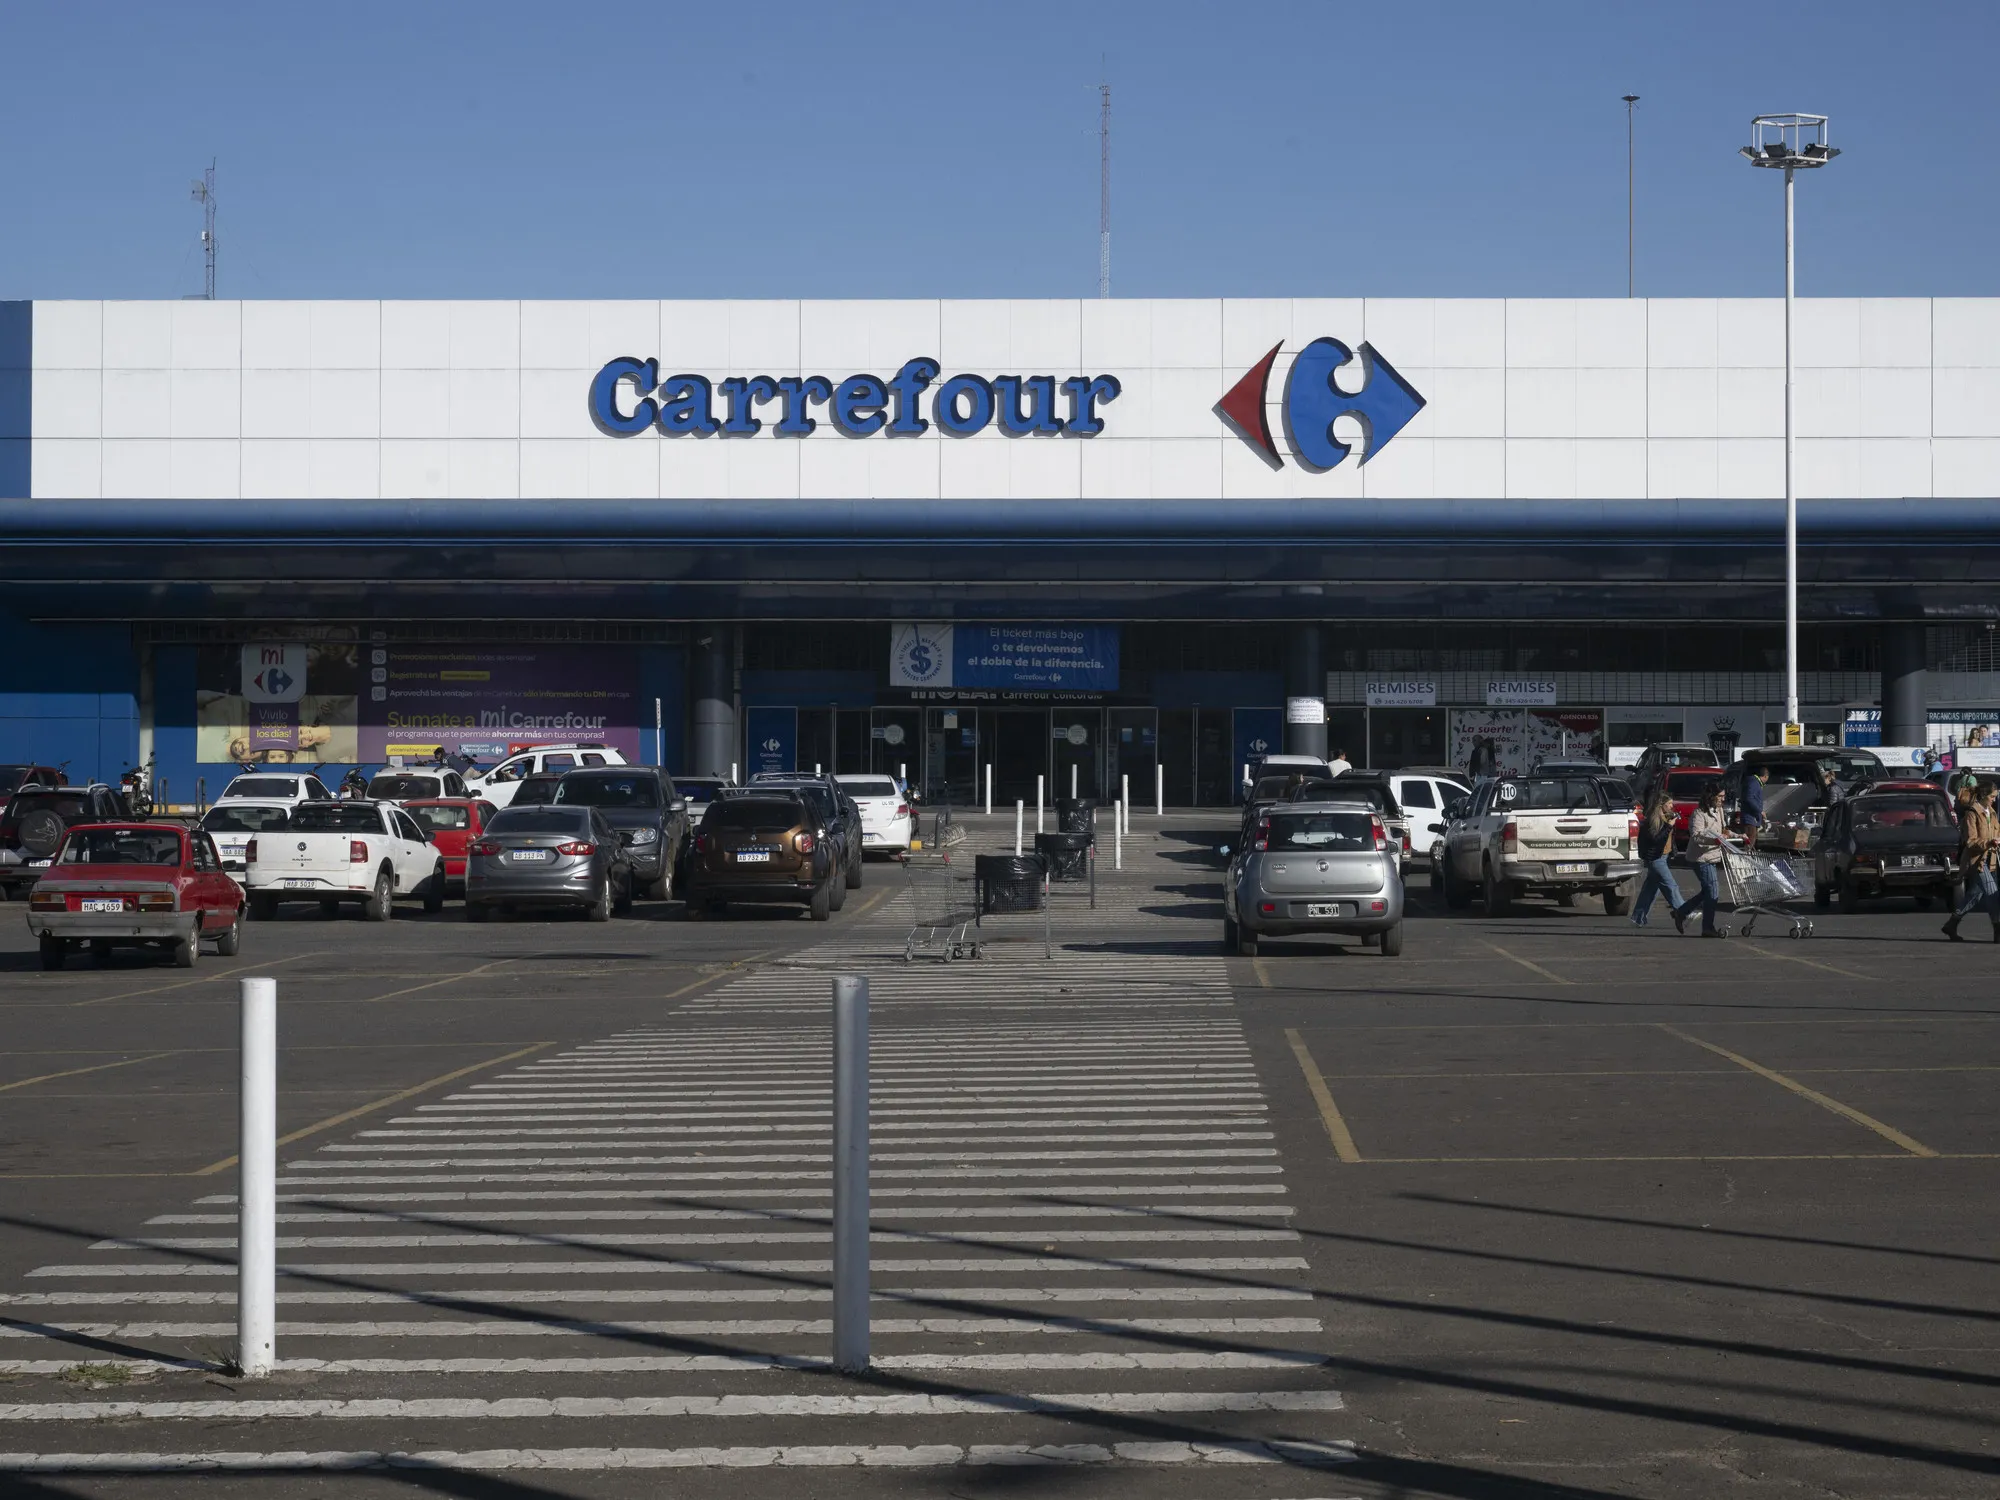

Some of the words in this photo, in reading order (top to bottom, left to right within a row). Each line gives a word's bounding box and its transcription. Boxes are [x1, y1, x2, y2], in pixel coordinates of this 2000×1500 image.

[590, 356, 1121, 438] Carrefour
[990, 628, 999, 638] El
[1002, 628, 1032, 638] ticket
[1060, 628, 1084, 642] bajo
[992, 644, 999, 652] o
[1002, 643, 1014, 652] te
[1016, 643, 1084, 654] devolvemos
[261, 644, 285, 665] mi
[968, 656, 978, 666] el
[981, 656, 1012, 666] doble
[1014, 657, 1029, 667] de
[1031, 657, 1041, 667] la
[1045, 657, 1105, 669] diferencia.
[1014, 673, 1047, 681] Carrefour
[1367, 683, 1435, 694] REMISES
[1488, 682, 1554, 693] REMISES
[430, 689, 441, 697] las
[442, 689, 473, 698] ventajas
[387, 711, 461, 728] Sumate
[464, 715, 475, 728] a
[481, 705, 506, 728] mi
[509, 711, 606, 729] Carrefour
[257, 729, 270, 738] los
[271, 728, 291, 738] días!
[1462, 724, 1474, 733] La
[1478, 725, 1512, 734] suerte
[396, 731, 433, 740] programa
[434, 732, 449, 740] que
[460, 730, 491, 740] permite
[525, 730, 542, 738] más
[568, 731, 605, 740] compras!
[1941, 755, 1953, 771] 5
[1502, 786, 1515, 797] 110
